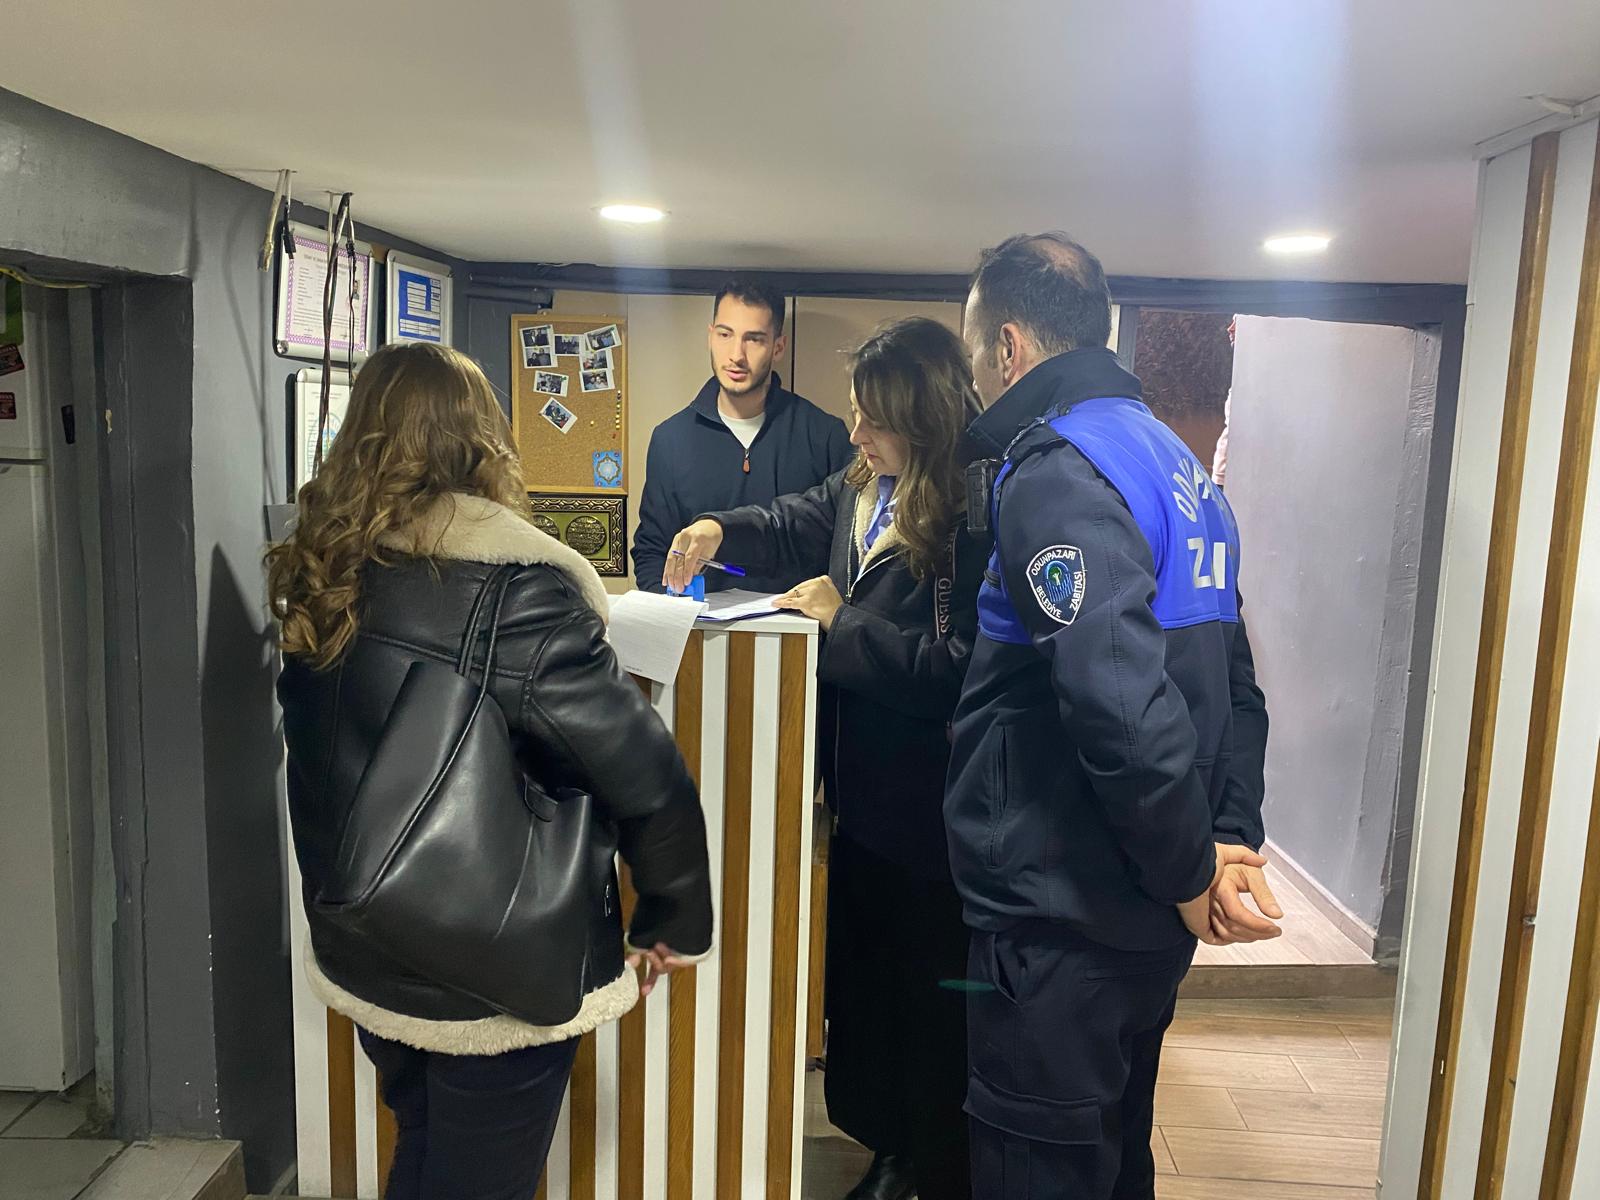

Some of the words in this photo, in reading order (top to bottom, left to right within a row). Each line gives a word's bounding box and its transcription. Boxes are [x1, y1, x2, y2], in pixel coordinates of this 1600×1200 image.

[1031, 549, 1077, 576] ODUNPAZARI
[938, 577, 953, 633] GUESS
[1036, 585, 1062, 618] BELEDİYE
[1069, 570, 1083, 611] ZABITASI
